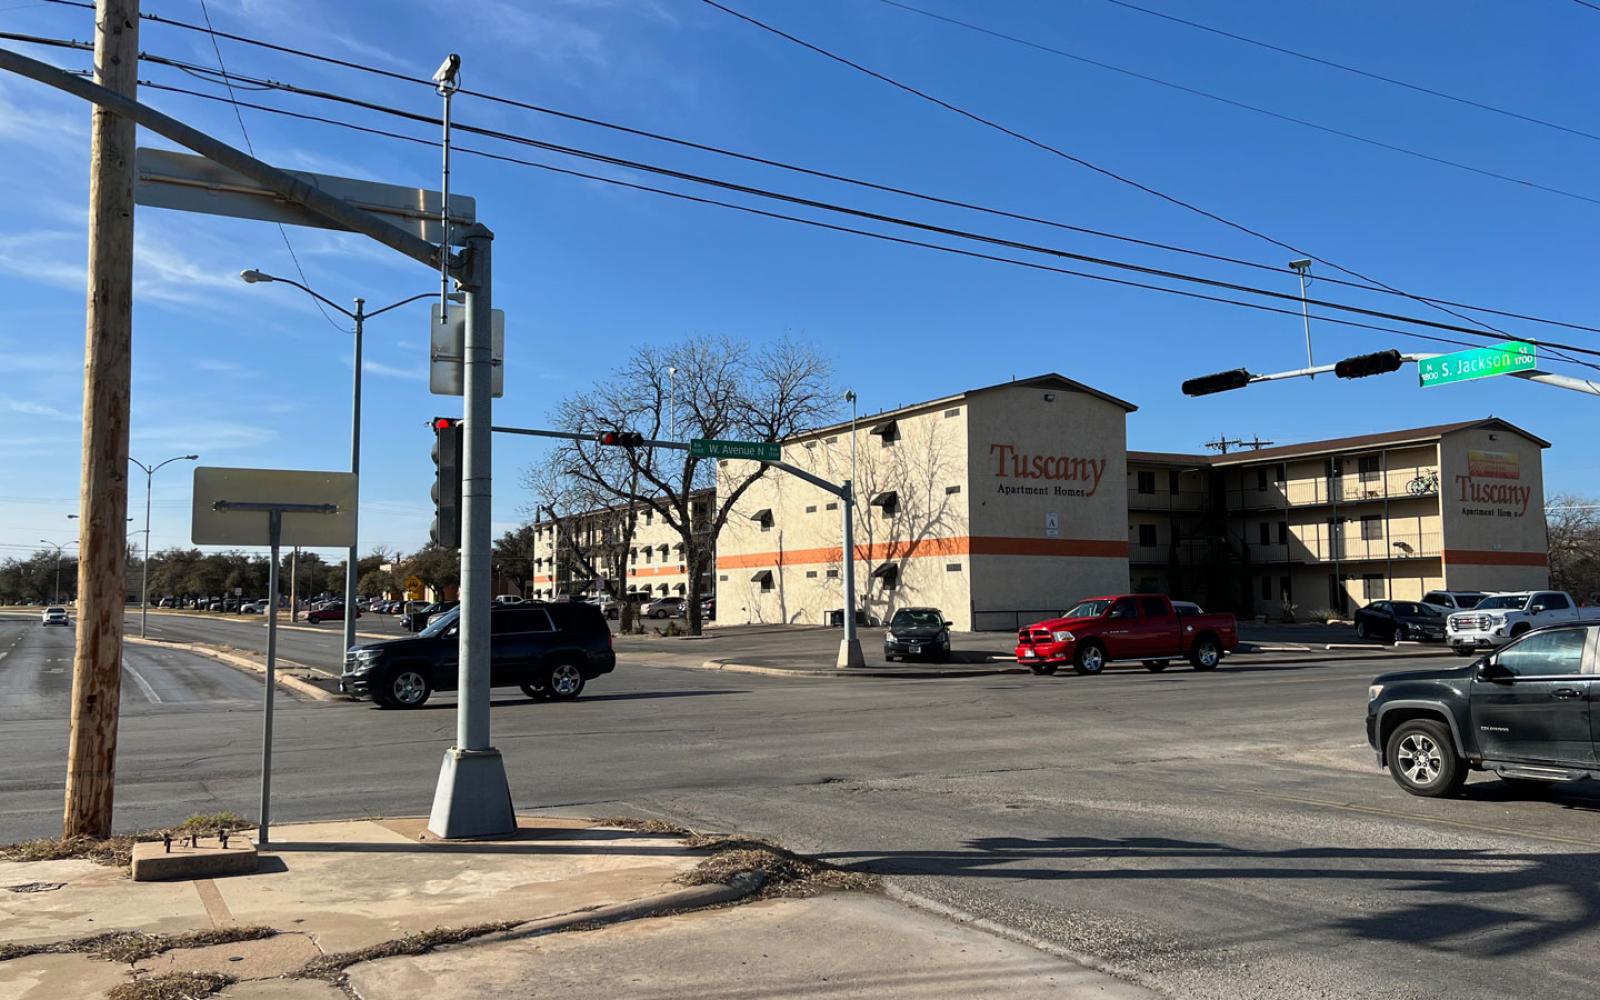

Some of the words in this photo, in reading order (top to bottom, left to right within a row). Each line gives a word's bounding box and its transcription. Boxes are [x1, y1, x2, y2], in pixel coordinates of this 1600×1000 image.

[1442, 362, 1453, 377] S.
[1457, 355, 1511, 375] Jackson
[1515, 355, 1533, 365] 1700
[709, 444, 720, 454] W.
[722, 445, 755, 456] Avenue
[757, 447, 764, 456] N
[990, 444, 1105, 496] Tuscany
[998, 484, 1048, 496] Apartment
[1054, 486, 1085, 496] Homes
[1456, 475, 1531, 517] Tuscany
